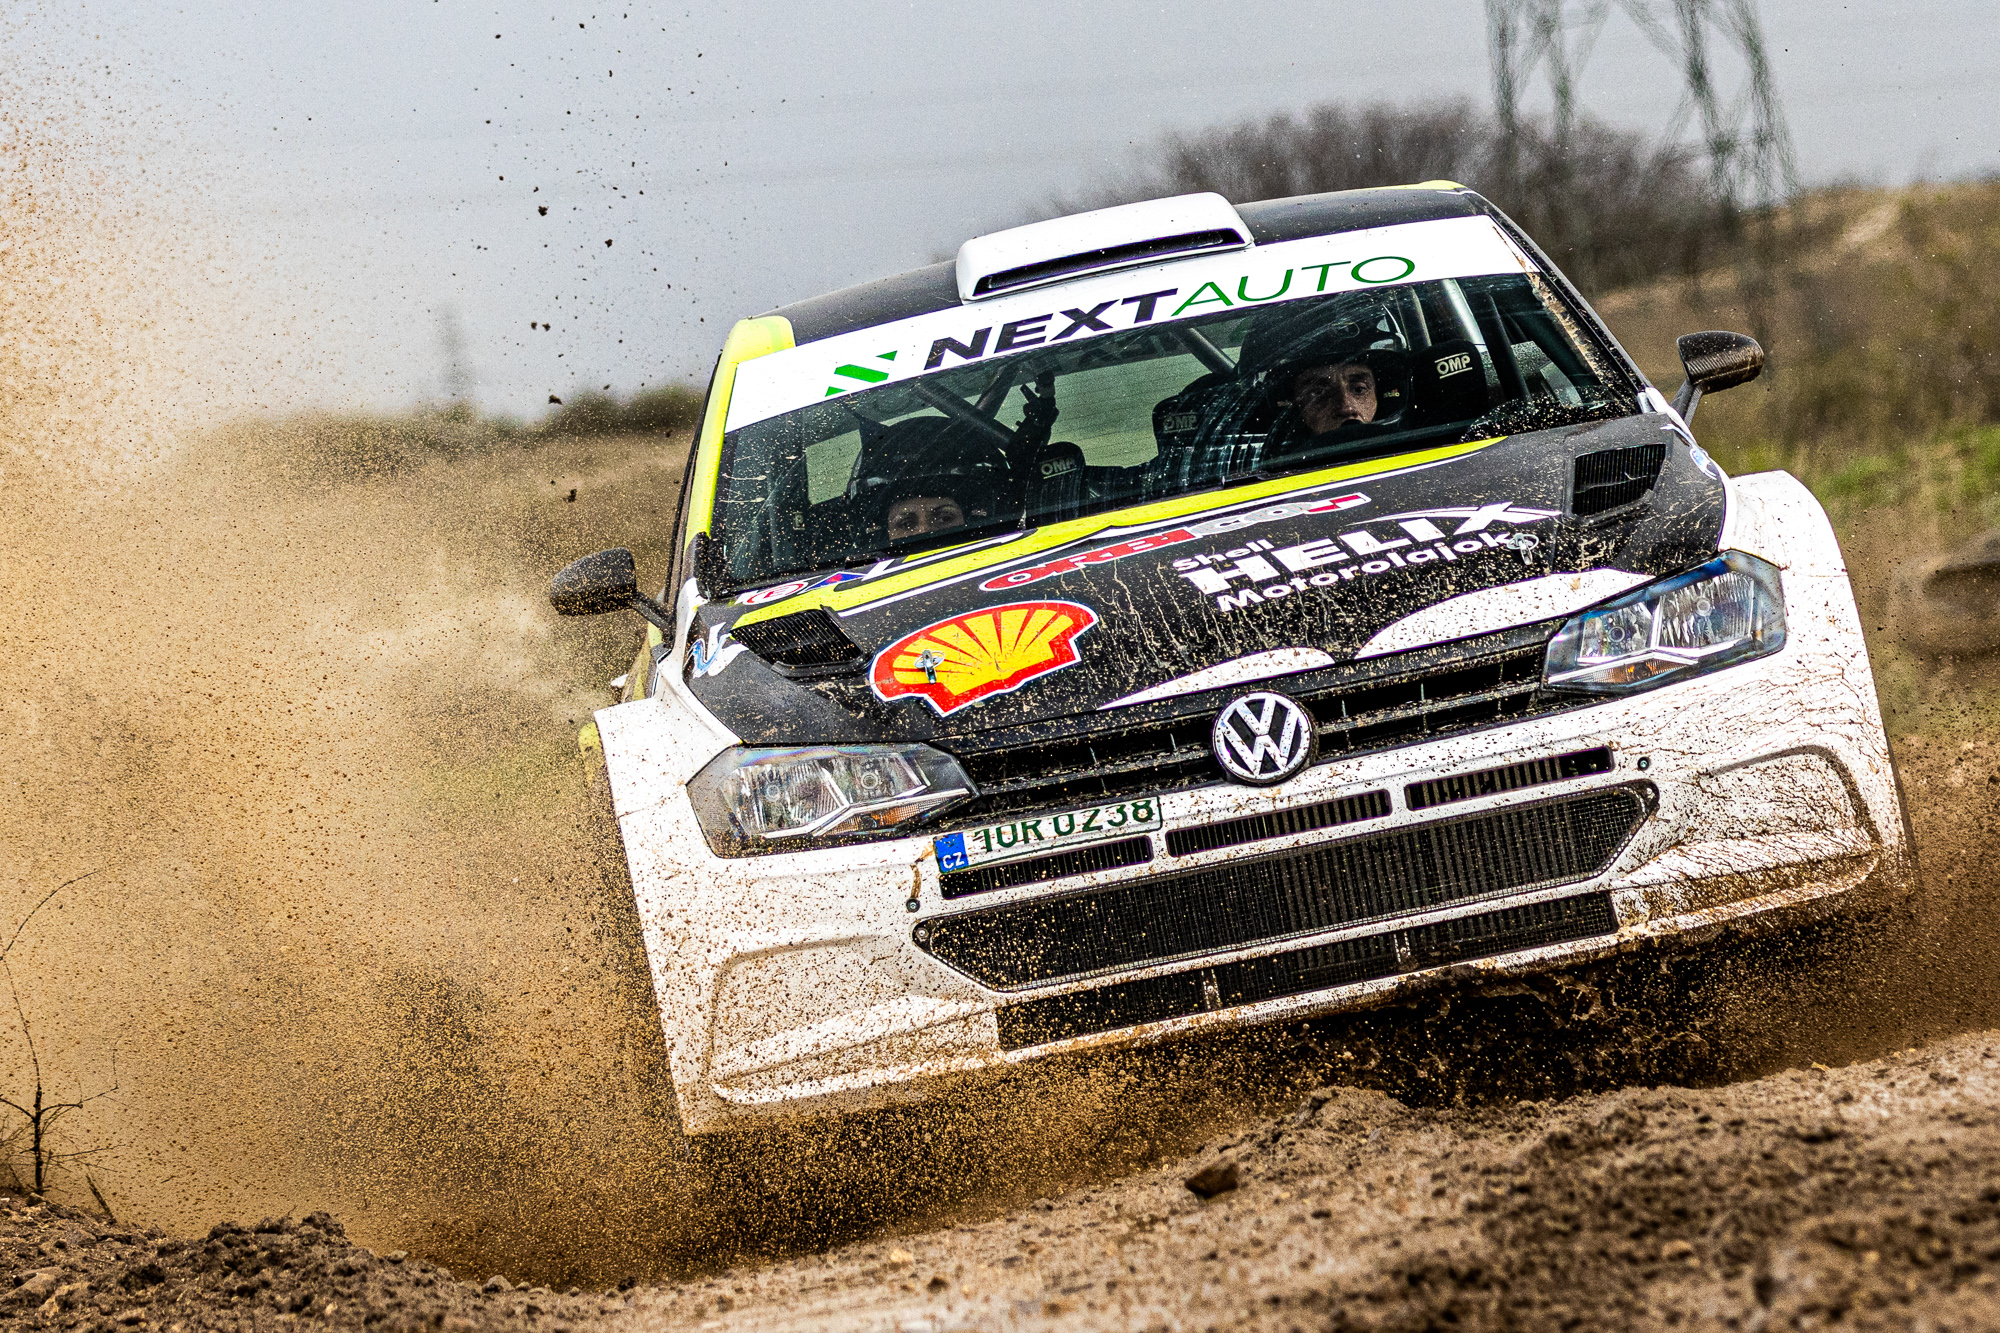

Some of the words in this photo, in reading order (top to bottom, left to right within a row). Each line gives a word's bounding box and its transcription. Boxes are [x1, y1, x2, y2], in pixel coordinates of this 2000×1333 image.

[1437, 355, 1471, 375] OMP
[1163, 415, 1197, 430] OMP
[1172, 539, 1274, 571] Shell
[1178, 501, 1563, 595] HELIX
[1217, 533, 1514, 612] Motorolajok
[942, 851, 965, 869] CZ
